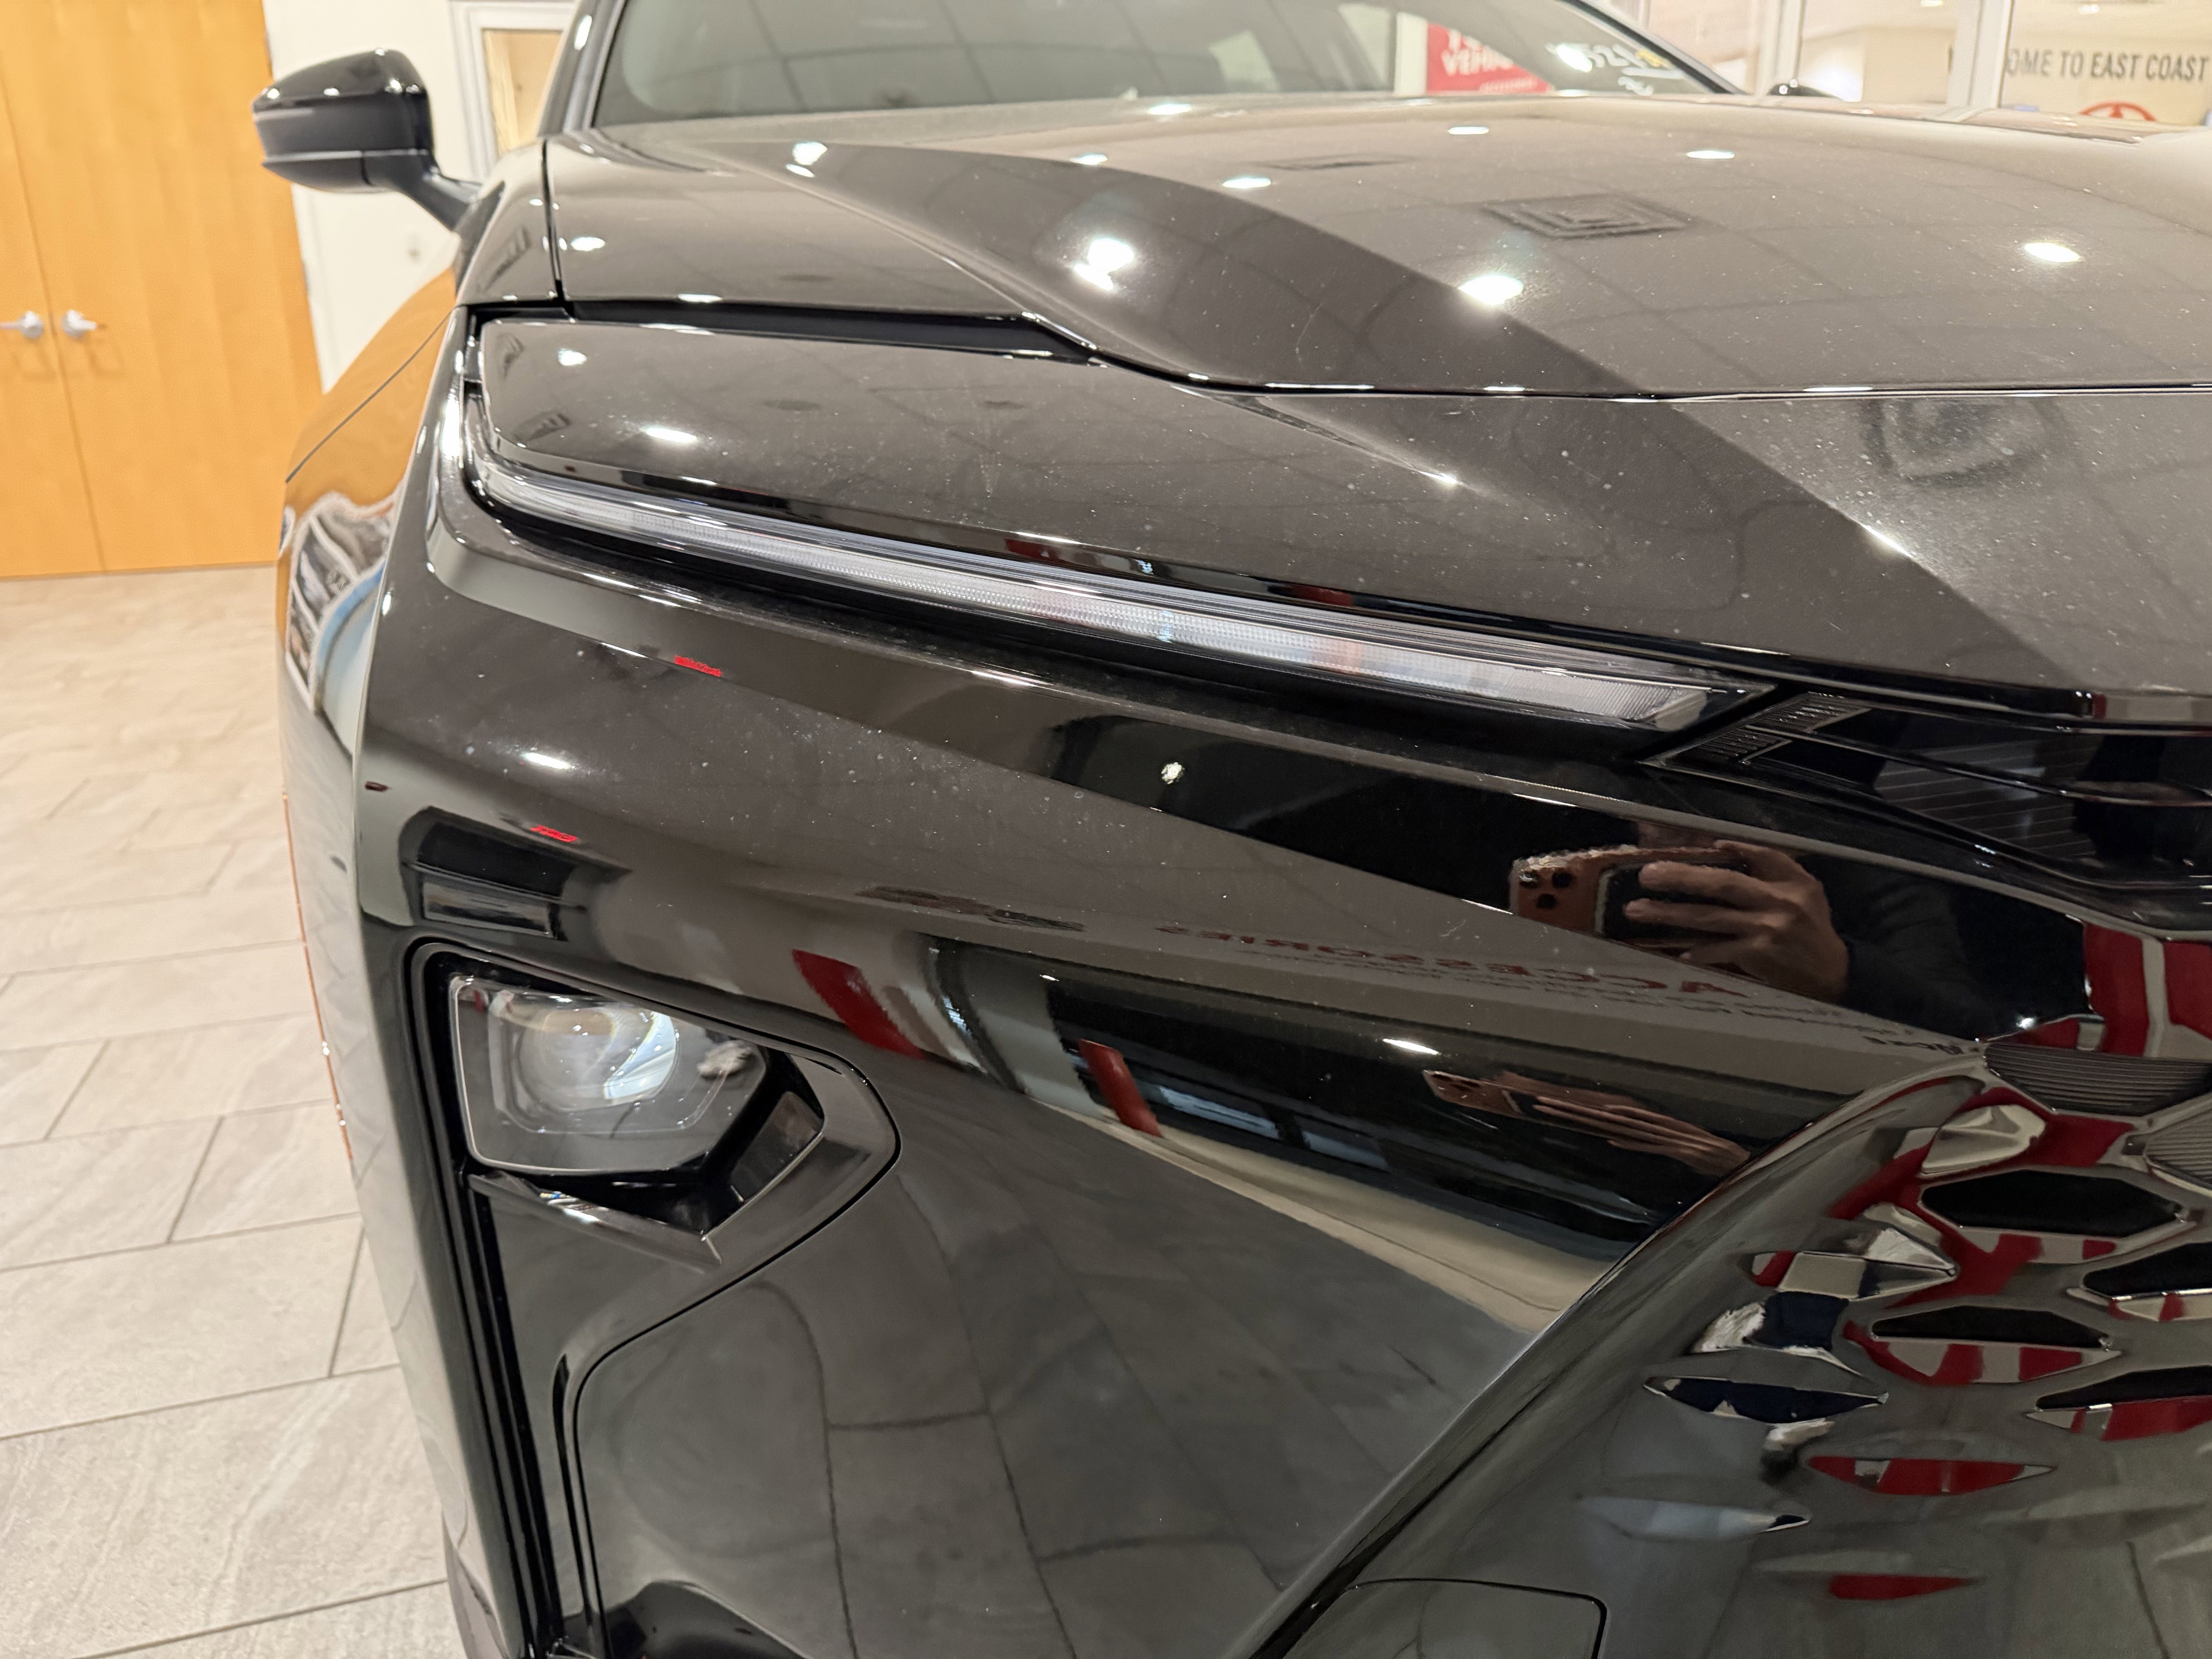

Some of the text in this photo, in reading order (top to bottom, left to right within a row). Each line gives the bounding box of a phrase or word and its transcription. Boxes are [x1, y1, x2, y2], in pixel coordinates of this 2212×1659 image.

[2060, 50, 2084, 77] TO
[2091, 52, 2143, 79] EAST
[2145, 54, 2210, 81] COAST
